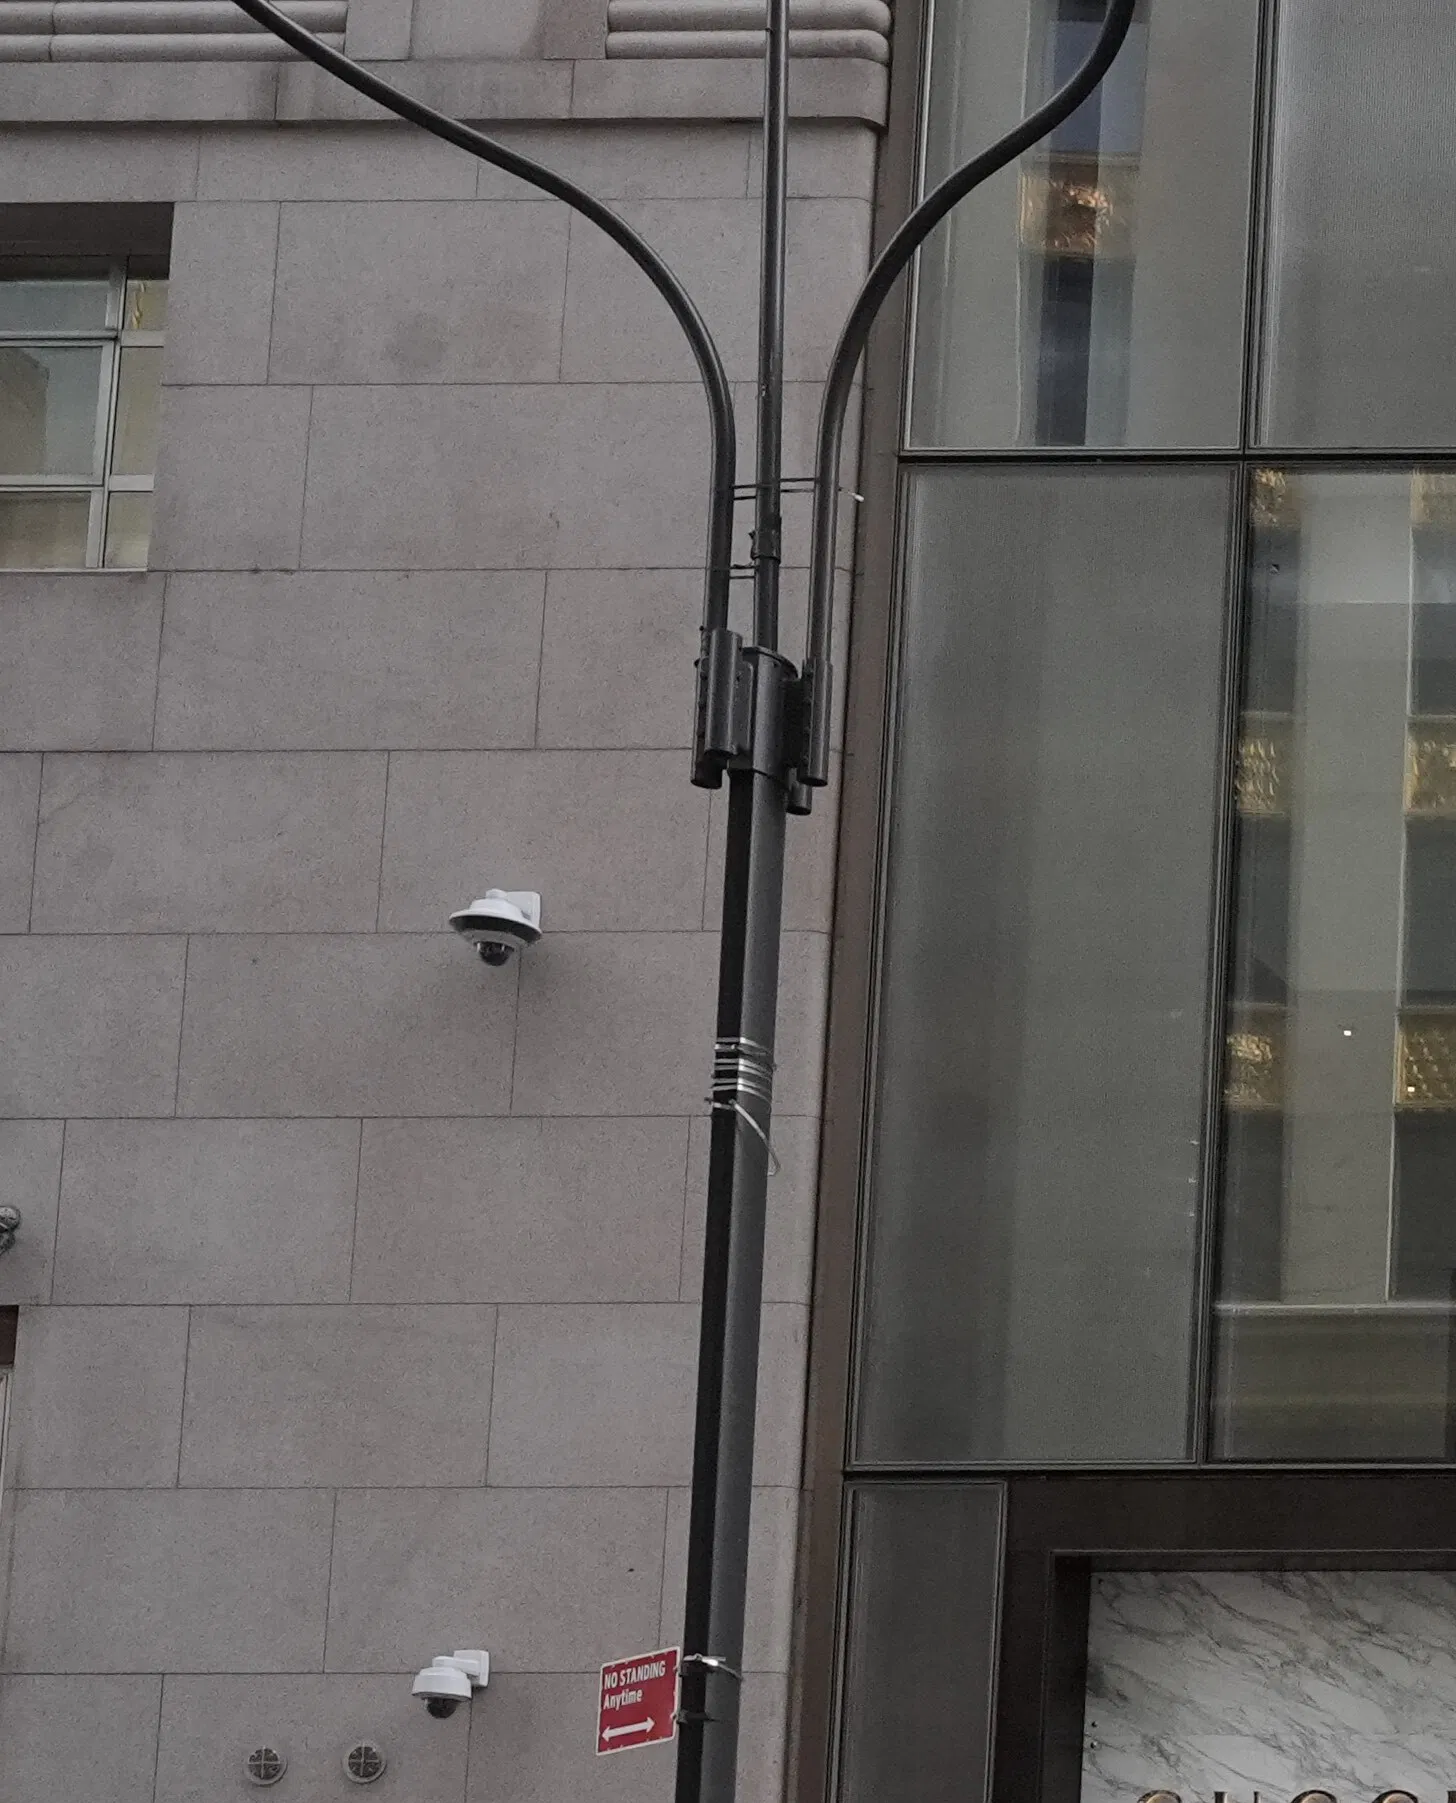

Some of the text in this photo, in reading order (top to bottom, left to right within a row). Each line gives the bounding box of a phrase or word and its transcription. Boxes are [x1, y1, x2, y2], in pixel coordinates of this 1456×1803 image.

[604, 1660, 666, 1690] NO STANDING
[603, 1689, 643, 1711] Anytime
